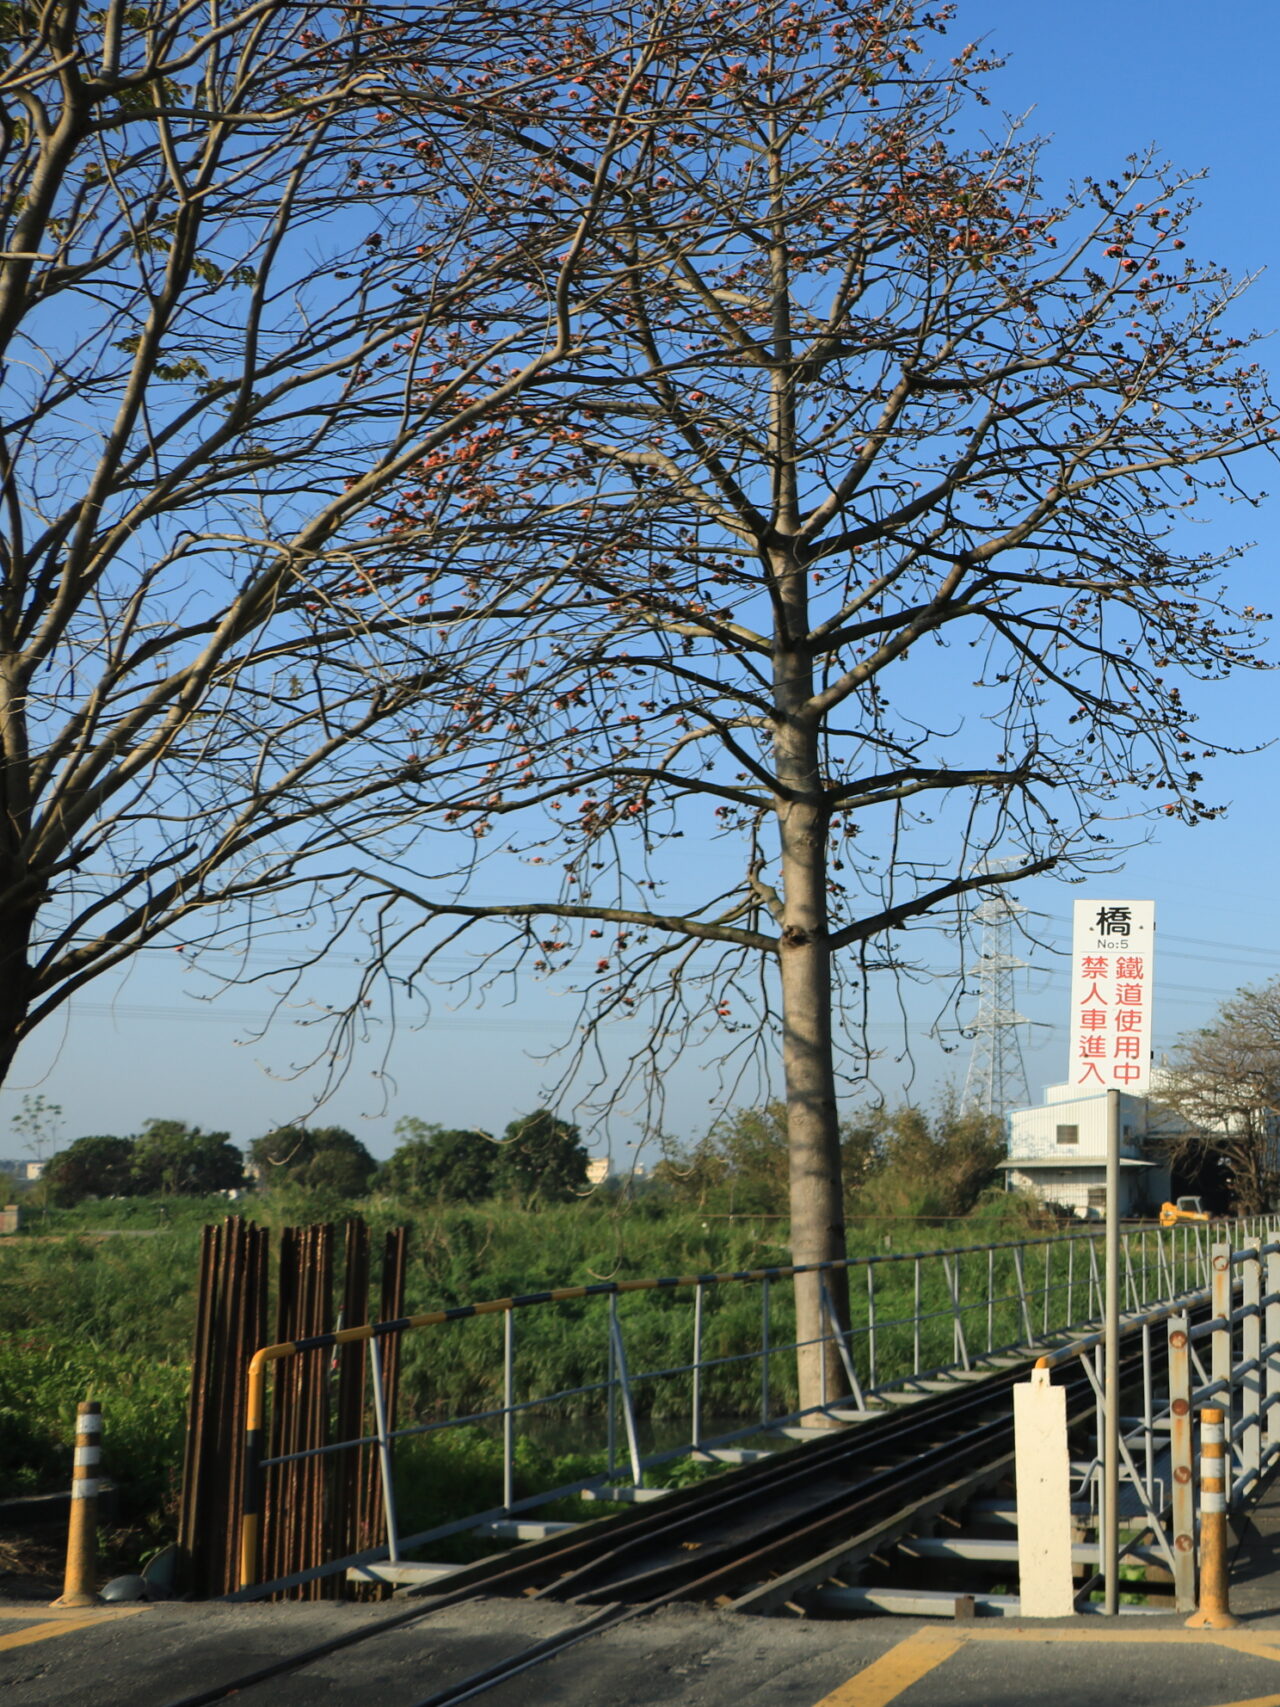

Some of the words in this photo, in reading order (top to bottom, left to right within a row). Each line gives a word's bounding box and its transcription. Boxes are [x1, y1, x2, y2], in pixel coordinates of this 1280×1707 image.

[1096, 906, 1132, 937] 橋
[1077, 955, 1109, 1086] 禁人車進入
[1113, 956, 1145, 1086] 鐵道使用中
